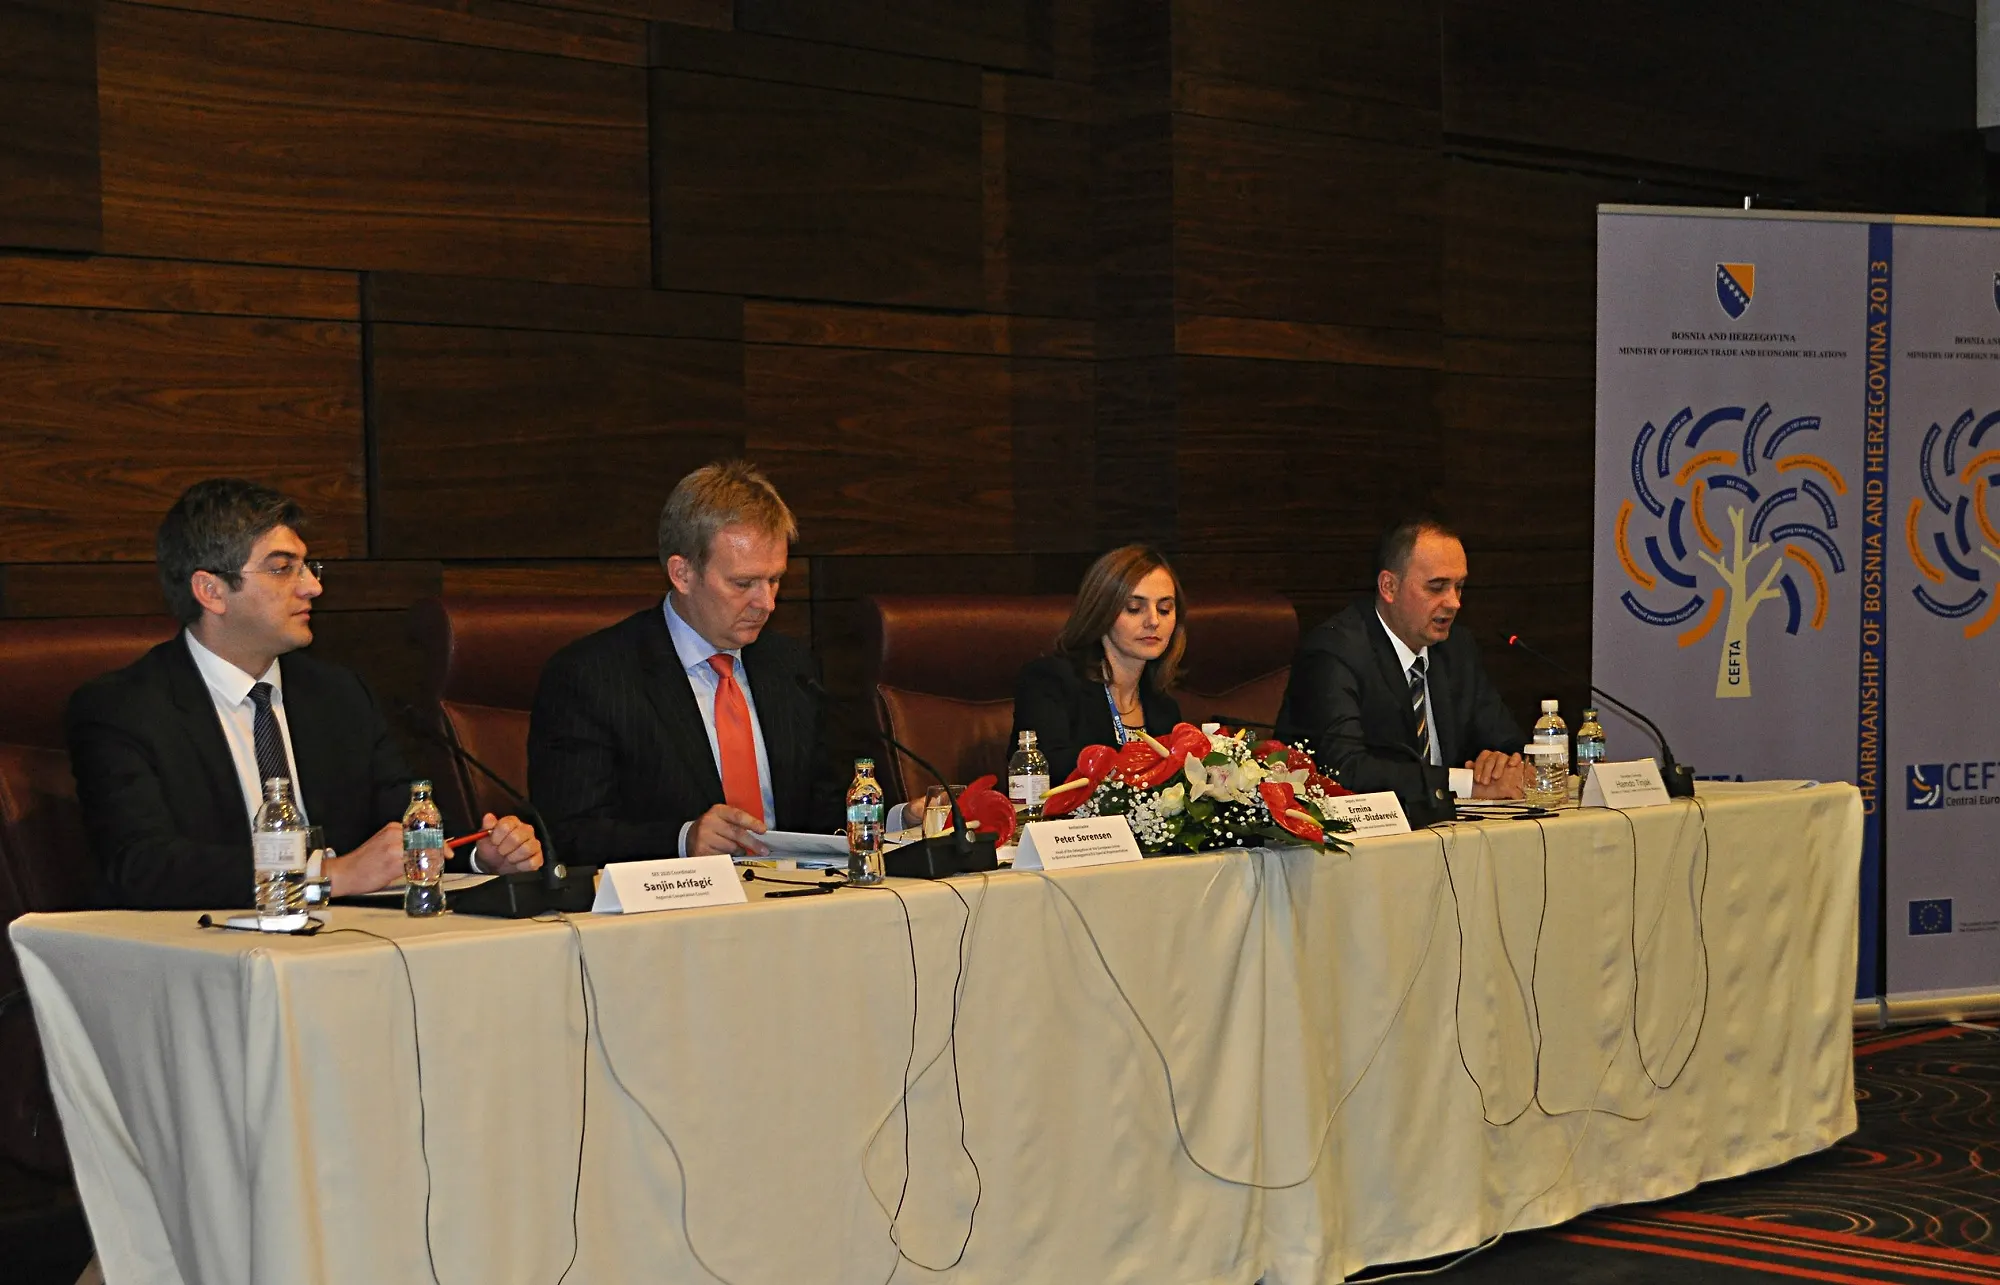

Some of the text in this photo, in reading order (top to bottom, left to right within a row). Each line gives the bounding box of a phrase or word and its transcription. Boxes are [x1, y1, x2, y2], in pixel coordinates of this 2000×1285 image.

[1672, 332, 1796, 342] BOSNIA AND HERZEGOVINA
[1987, 336, 2000, 346] AN
[1619, 347, 1847, 359] MINISTRY OF FOREIGN TRADE AND ECONOMIC RELATIONS
[1861, 260, 1888, 815] CHAIRMANSHIP OF BOSNIA AND HERZEGOVINA 2013
[1728, 640, 1741, 685] CEFTA
[1946, 761, 2000, 792] CEF
[1946, 796, 1977, 807] Central
[1348, 804, 1373, 815] Ermina
[1054, 832, 1112, 844] Peter Sorensen
[644, 877, 713, 892] Sanjin Arifagić
